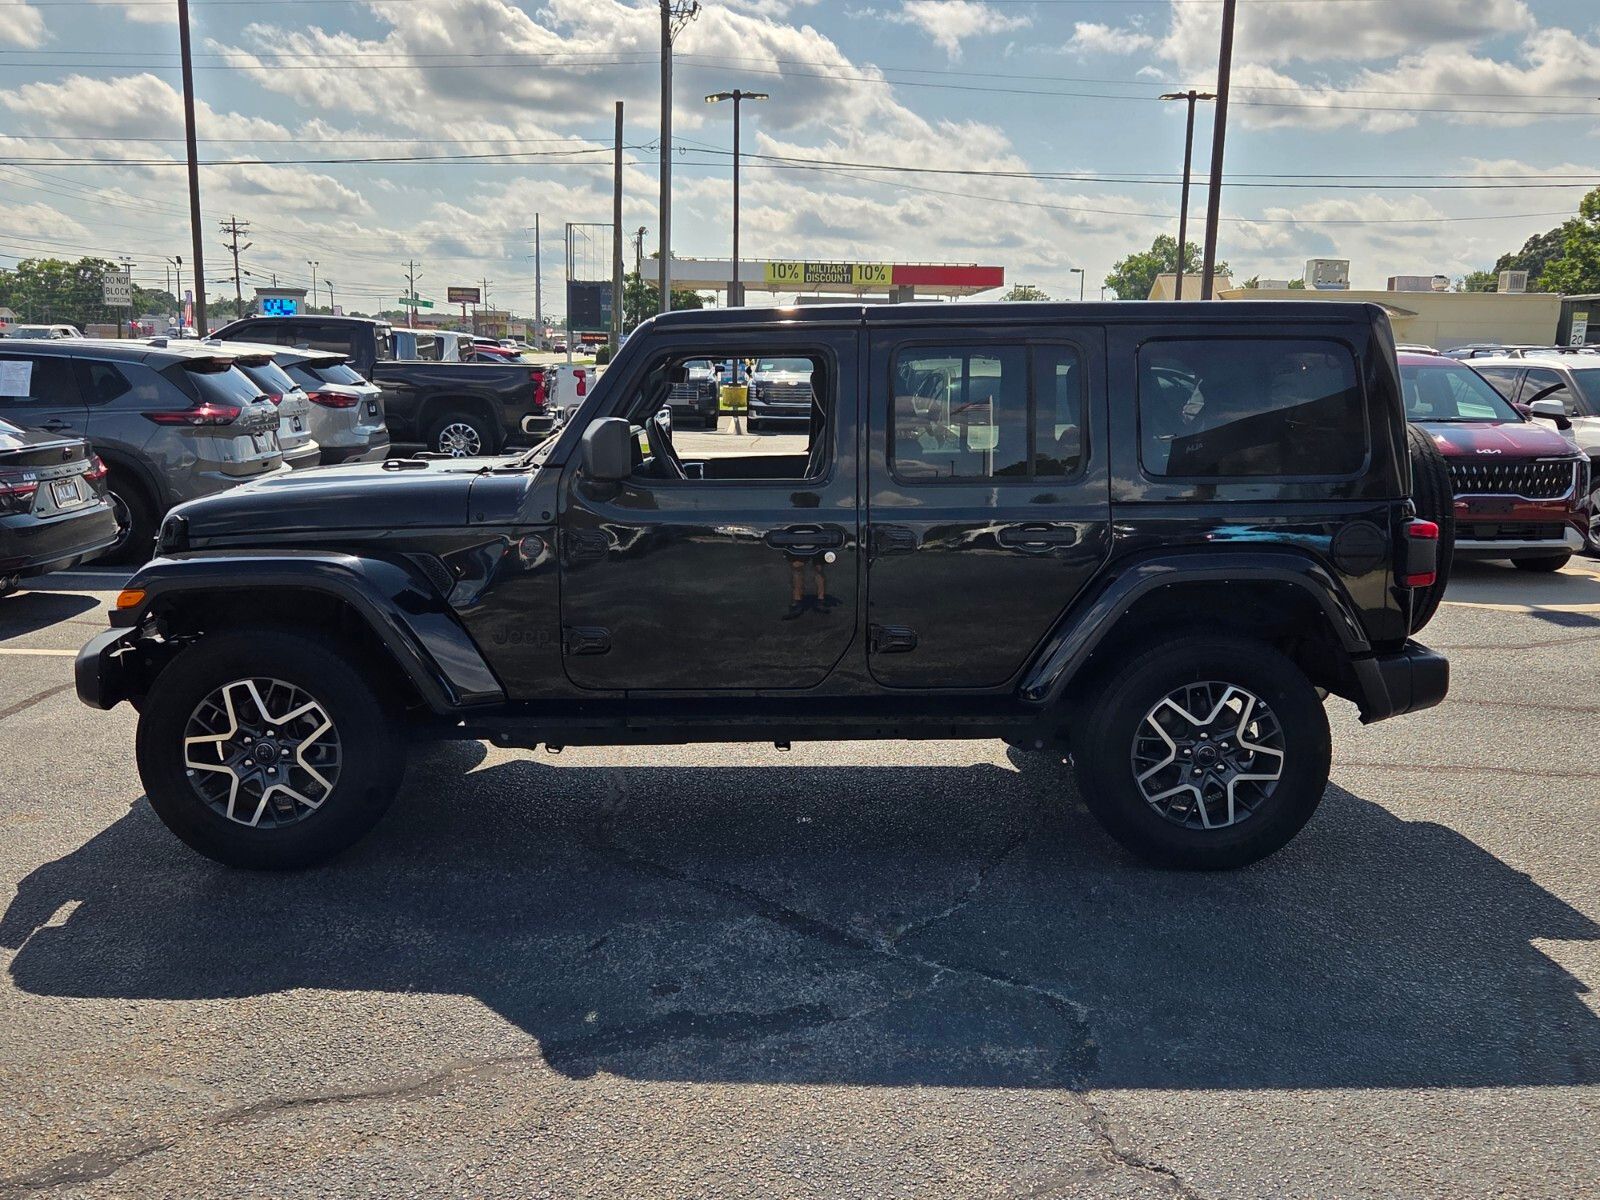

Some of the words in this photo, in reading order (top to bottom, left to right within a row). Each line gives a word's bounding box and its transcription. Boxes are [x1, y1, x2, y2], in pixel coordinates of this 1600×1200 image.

[771, 263, 799, 279] 10%
[808, 264, 848, 274] MILITARY
[858, 265, 886, 281] 10%
[105, 276, 115, 284] DO
[116, 276, 129, 285] NOT
[806, 273, 851, 283] DISCOUNT!
[105, 287, 130, 296] BLOCK
[1571, 334, 1583, 345] 20
[23, 473, 37, 481] ALM
[58, 484, 77, 498] ALM
[492, 624, 551, 648] Jeep
